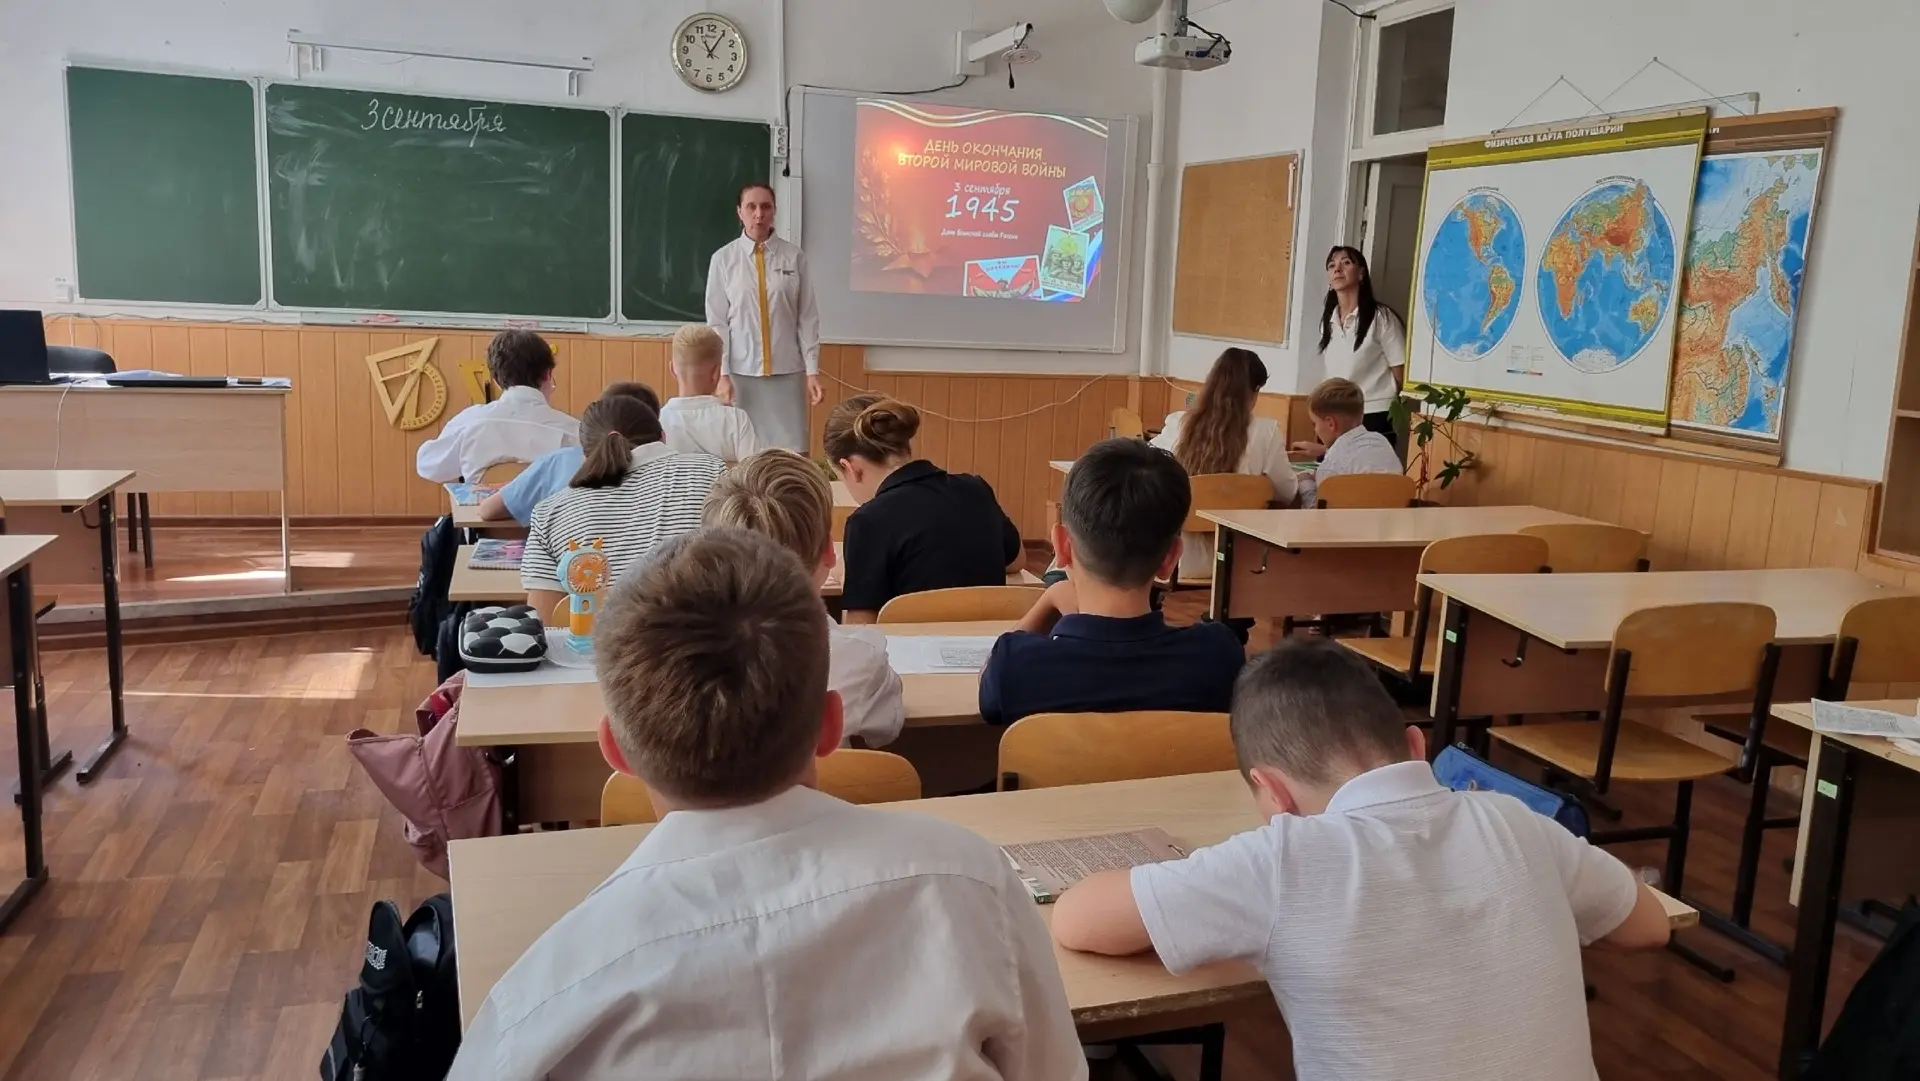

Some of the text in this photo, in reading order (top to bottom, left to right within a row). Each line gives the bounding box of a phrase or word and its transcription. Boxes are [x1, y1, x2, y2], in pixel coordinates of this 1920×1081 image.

[695, 26, 704, 34] 11
[706, 24, 717, 33] 12
[685, 35, 695, 44] 10
[728, 40, 734, 48] 2
[682, 46, 689, 55] 9
[731, 52, 737, 61] 3
[685, 59, 692, 68] 8
[694, 69, 700, 78] 7
[727, 65, 734, 73] 4
[706, 74, 712, 83] 6
[718, 73, 724, 81] 5
[1484, 135, 1534, 148] ФИЗИЧЕСКАЯ
[1537, 131, 1563, 143] КАРТА
[924, 139, 1043, 160] ДЕНЬ ОКОНЧАНИЯ
[897, 152, 1067, 179] ВТОРОЙ МИРОВОЙ ВОЙНЫ
[954, 182, 1011, 199] 3 сентября
[945, 195, 1020, 222] 1945
